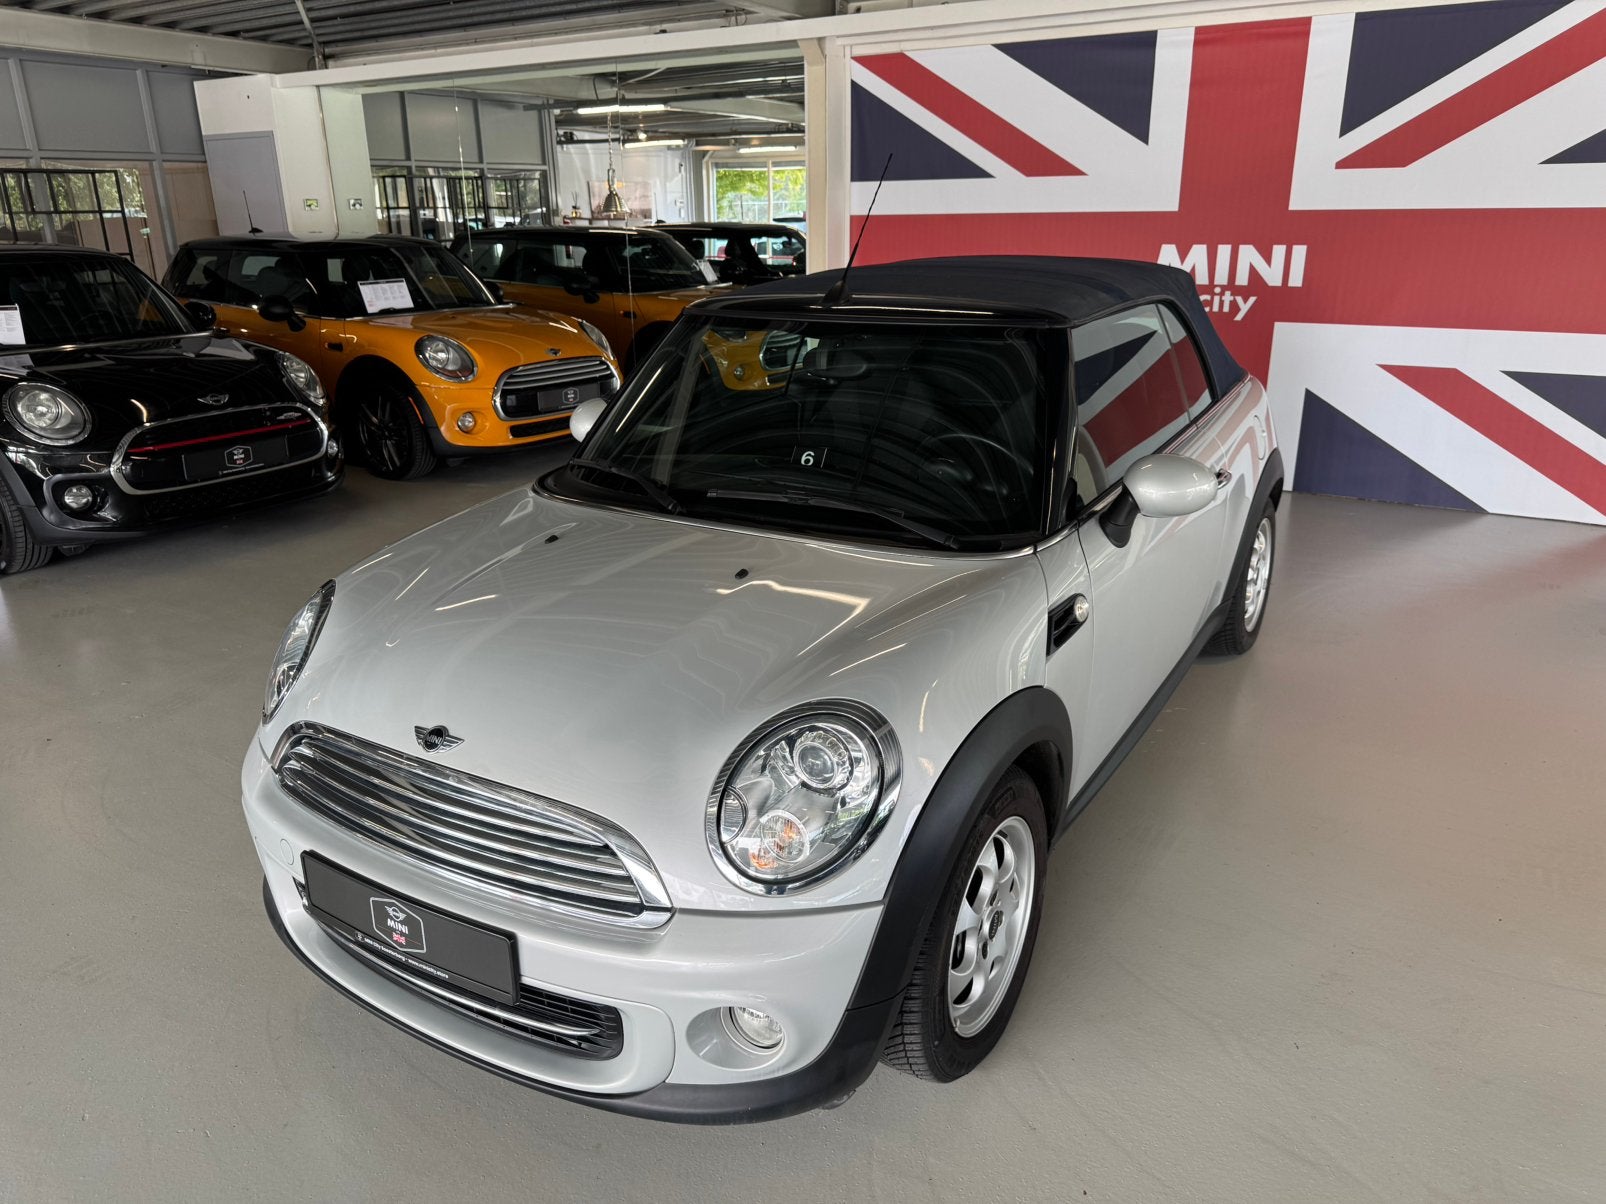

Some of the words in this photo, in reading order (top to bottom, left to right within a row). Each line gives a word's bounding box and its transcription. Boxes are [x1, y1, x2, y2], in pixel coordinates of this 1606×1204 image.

[1157, 243, 1308, 287] MINI
[801, 451, 815, 466] 6
[387, 918, 408, 934] MINI
